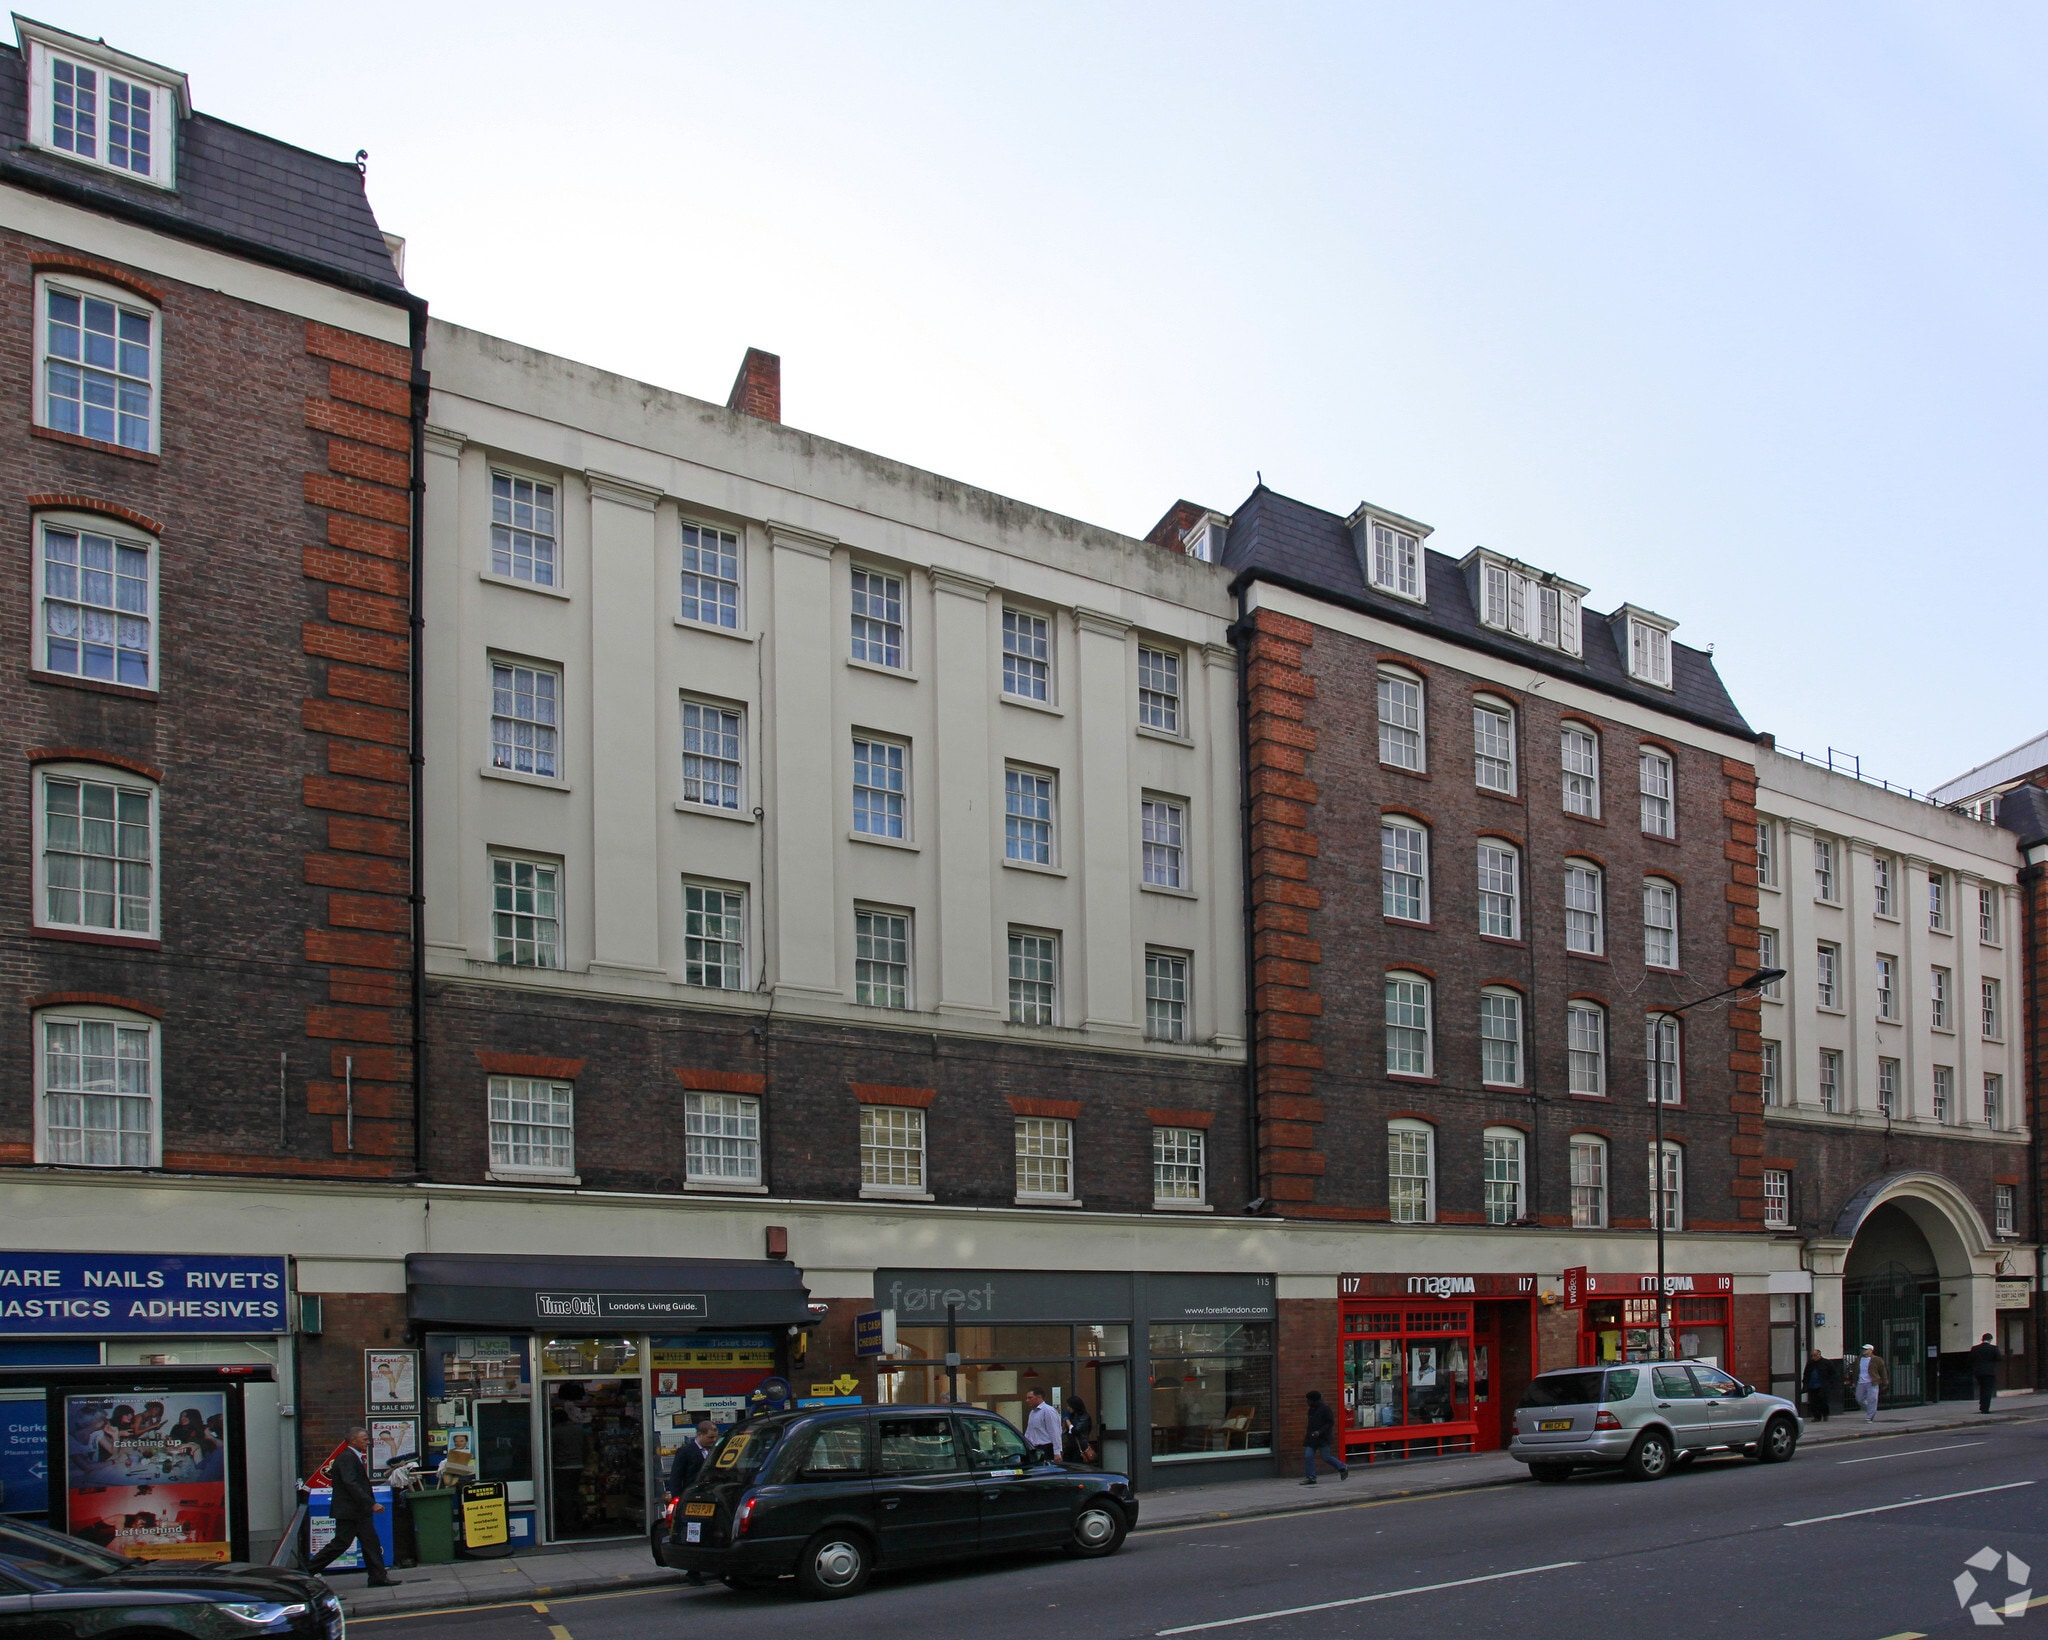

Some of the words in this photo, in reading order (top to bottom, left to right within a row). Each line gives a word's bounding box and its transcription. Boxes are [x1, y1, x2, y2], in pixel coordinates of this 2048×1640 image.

[84, 1270, 164, 1288] NAILS
[187, 1272, 279, 1289] RIVETS
[1256, 1278, 1270, 1286] 115
[1343, 1277, 1361, 1293] 117
[1518, 1277, 1533, 1291] 117
[1586, 1277, 1596, 1291] 19
[1718, 1277, 1730, 1289] 119
[1641, 1276, 1694, 1296] mgMA
[128, 1301, 279, 1318] ADHESIVES
[540, 1296, 571, 1314] Time
[571, 1297, 596, 1315] Out
[608, 1302, 645, 1311] London's
[647, 1302, 671, 1312] Living
[672, 1302, 698, 1311] Guide.
[1184, 1306, 1268, 1315] www.forestlondon.com
[859, 1322, 867, 1333] WE
[867, 1320, 881, 1330] CASH
[477, 1340, 509, 1350] Lyca
[742, 1340, 764, 1348] Stop
[859, 1335, 882, 1347] CHEQUES
[113, 1438, 164, 1449] Catching
[167, 1438, 182, 1447] up
[728, 1437, 747, 1448] HAIL
[115, 1528, 142, 1537] Left
[142, 1525, 183, 1535] behind
